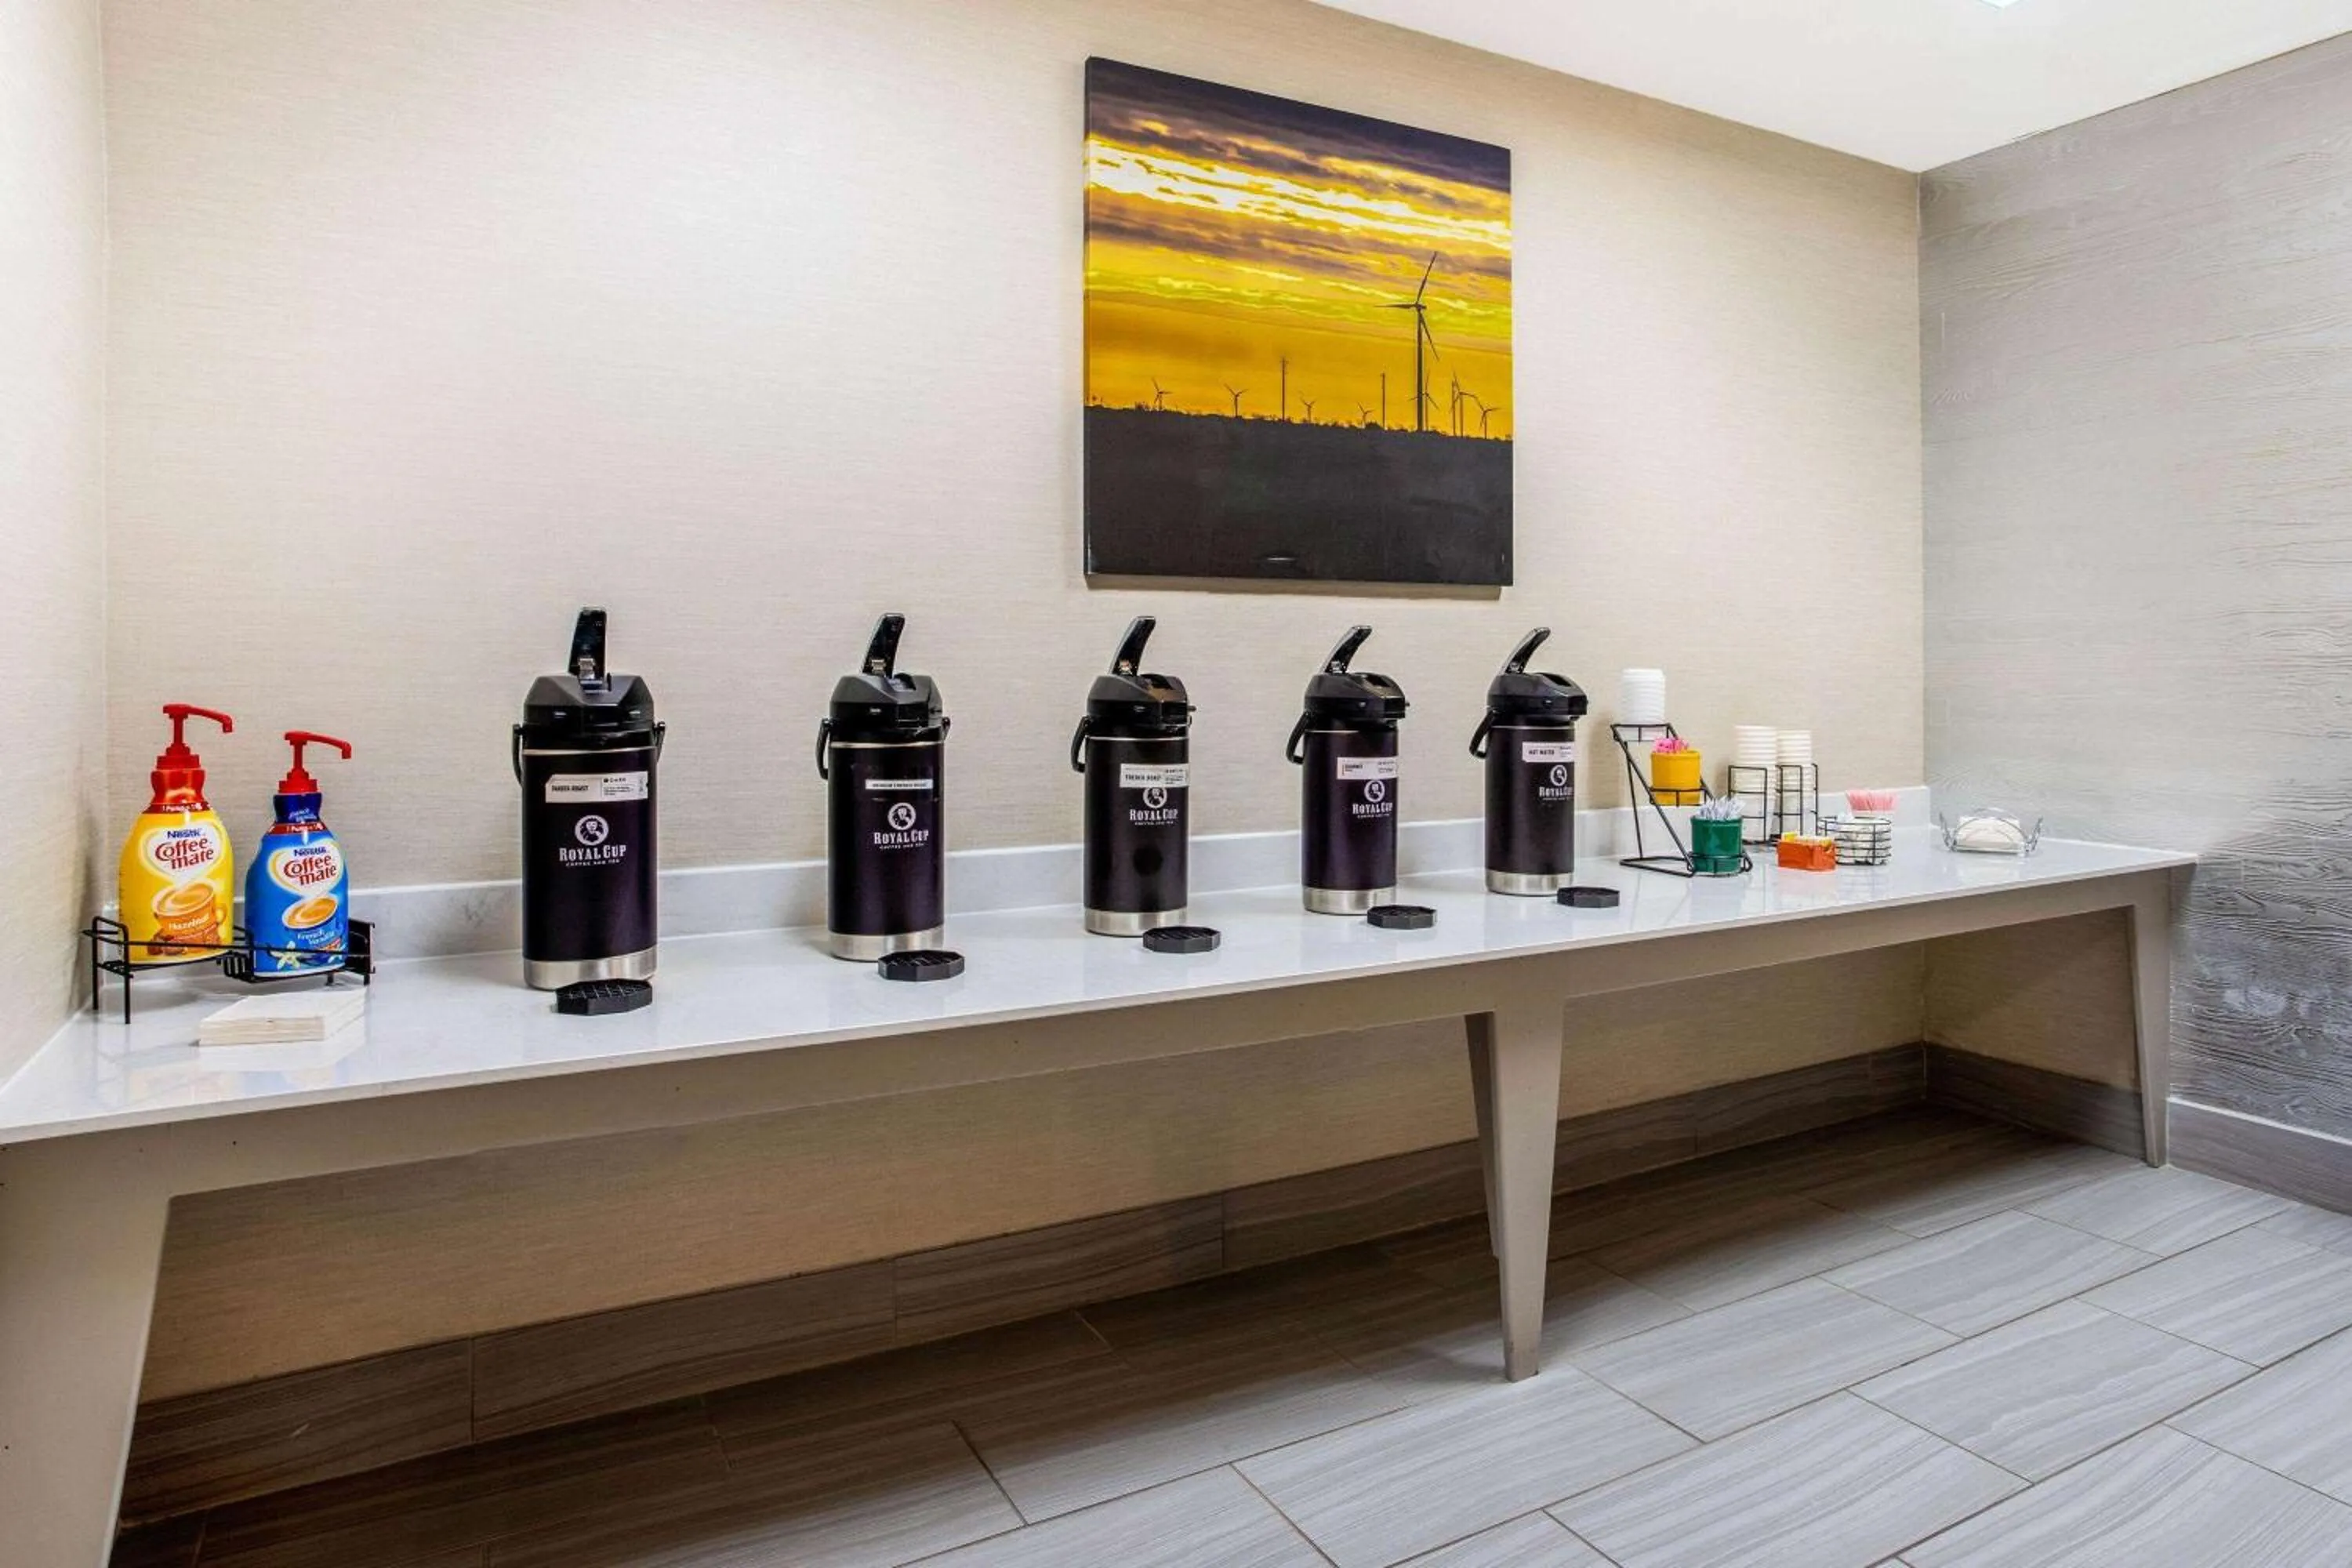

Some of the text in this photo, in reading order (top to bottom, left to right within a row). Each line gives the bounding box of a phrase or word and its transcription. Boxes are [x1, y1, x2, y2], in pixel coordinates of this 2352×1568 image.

[1129, 808, 1179, 821] ROYAL CUP
[1352, 803, 1380, 815] ROYAL
[873, 829, 929, 844] ROYAL CUP
[155, 837, 208, 862] Coffee
[171, 848, 214, 870] mate
[559, 844, 626, 862] ROYAL CUP
[284, 855, 332, 878] Coffee
[299, 865, 336, 886] mate
